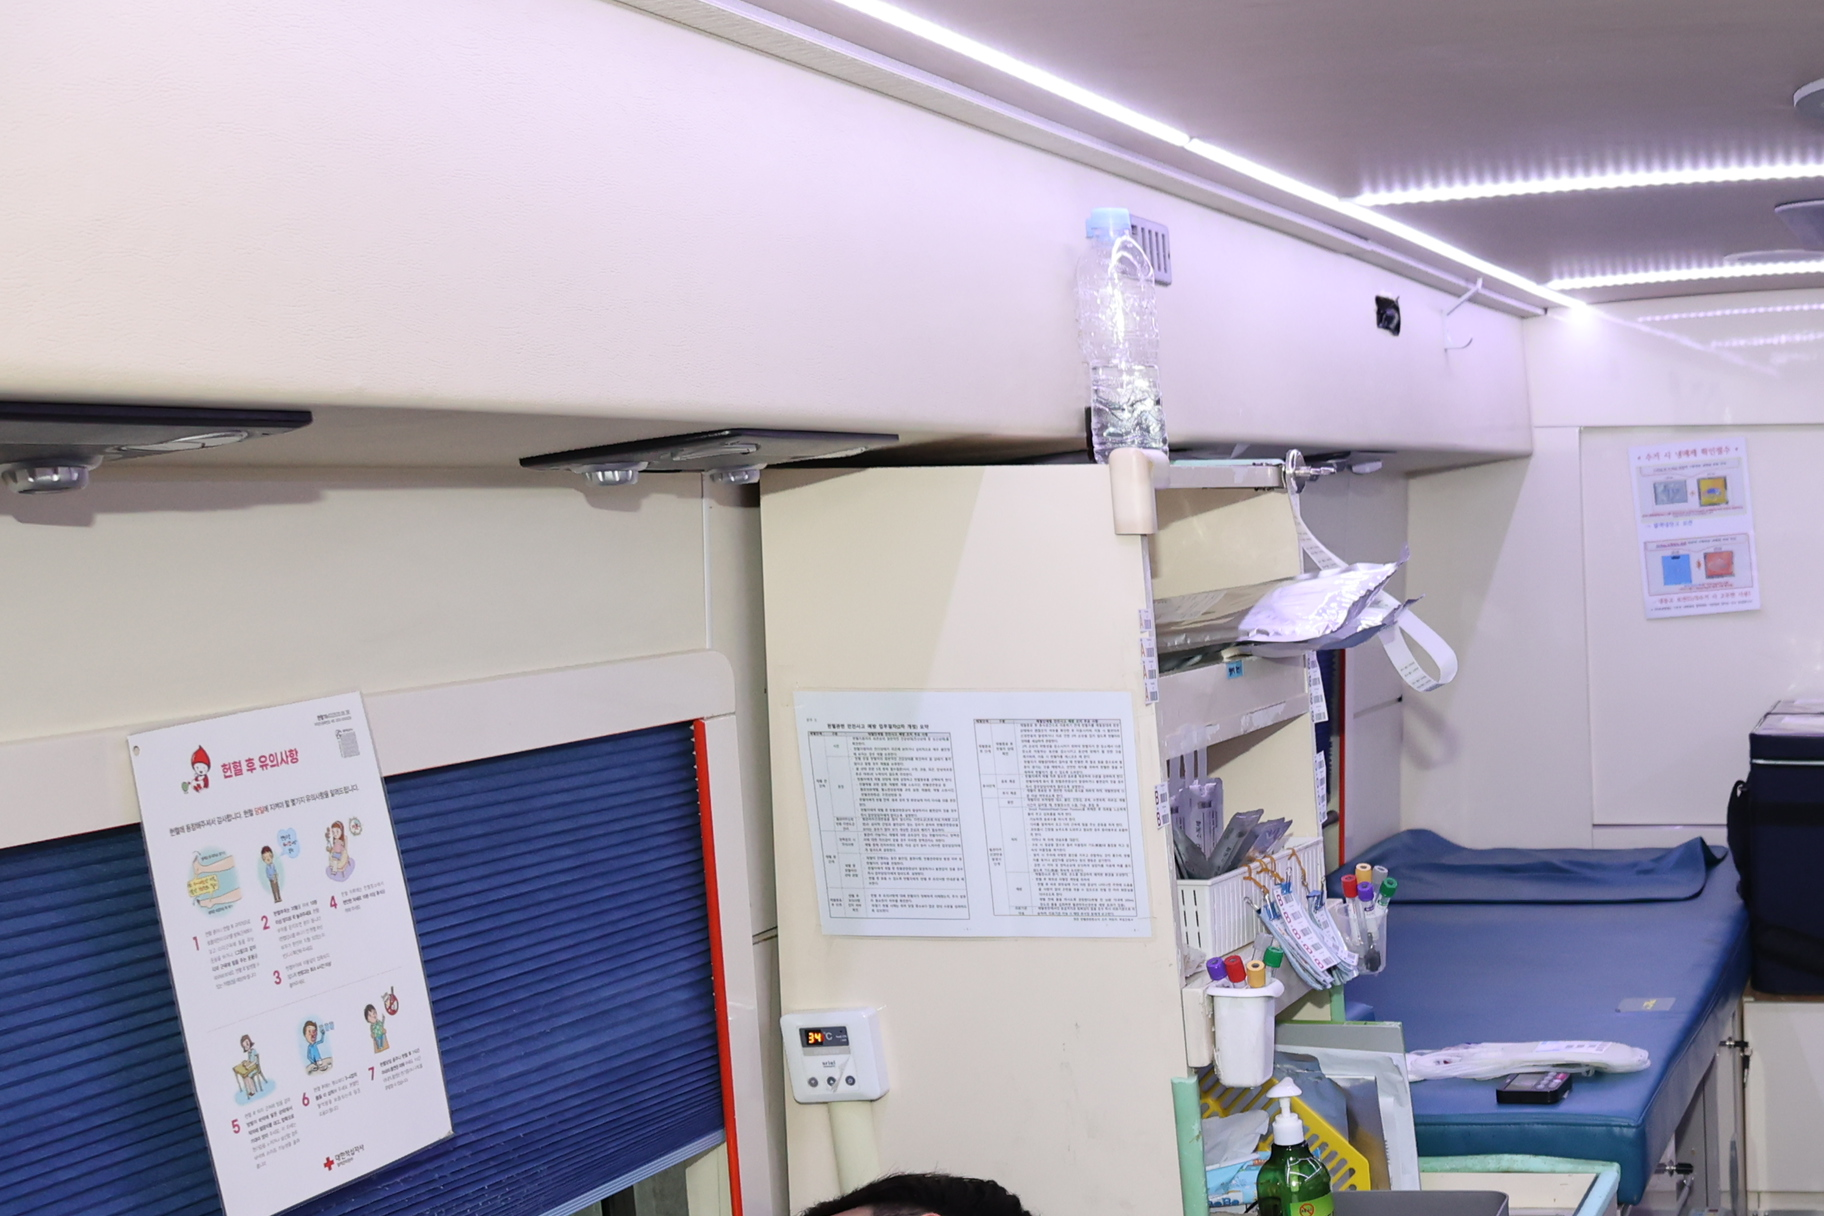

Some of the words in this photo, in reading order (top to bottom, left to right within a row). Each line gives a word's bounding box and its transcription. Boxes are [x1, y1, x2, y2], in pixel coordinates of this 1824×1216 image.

[221, 760, 244, 779] 헌혈
[245, 757, 257, 774] 후
[258, 748, 300, 771] 유의사항
[330, 895, 338, 909] 4
[261, 915, 270, 930] 2
[193, 936, 200, 951] 1
[273, 970, 282, 985] 3
[808, 1032, 823, 1044] 34
[368, 1066, 375, 1081] 7
[302, 1092, 310, 1107] 6
[231, 1119, 241, 1134] 5
[334, 1144, 365, 1161] 대한적십자사
